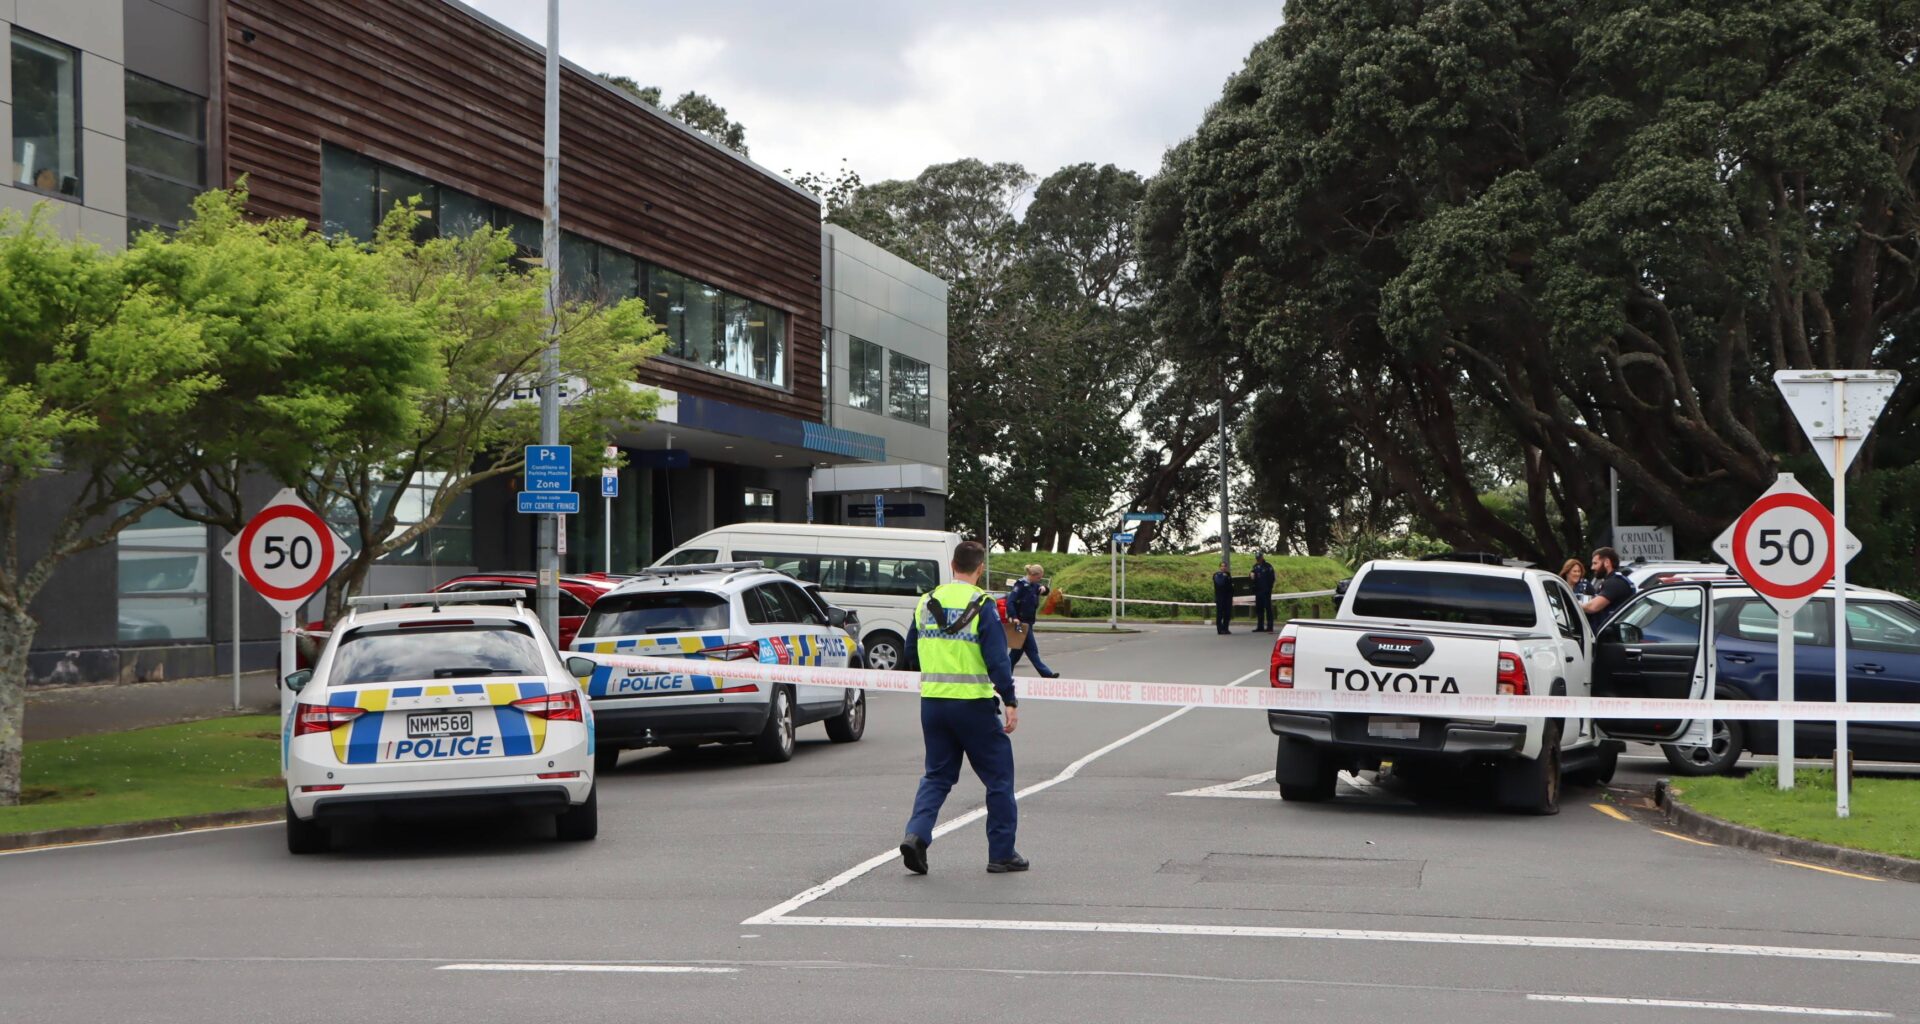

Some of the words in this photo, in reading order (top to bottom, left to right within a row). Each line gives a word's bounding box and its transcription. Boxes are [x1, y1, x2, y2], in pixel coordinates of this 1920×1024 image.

[536, 479, 560, 489] Zone
[520, 502, 532, 510] CITY
[535, 502, 555, 510] CENTRE
[556, 502, 576, 510] FRINGE
[1620, 532, 1666, 543] CRIMINAL
[264, 536, 313, 570] 50
[1622, 544, 1629, 554] &
[1632, 544, 1665, 554] FAMILY
[1759, 528, 1814, 566] 50
[820, 637, 846, 657] POLICE
[1378, 643, 1412, 652] HILUX
[619, 675, 684, 692] POLICE
[1324, 666, 1460, 694] TOYOTA
[410, 716, 469, 732] NMM560
[394, 736, 494, 760] POLICE
